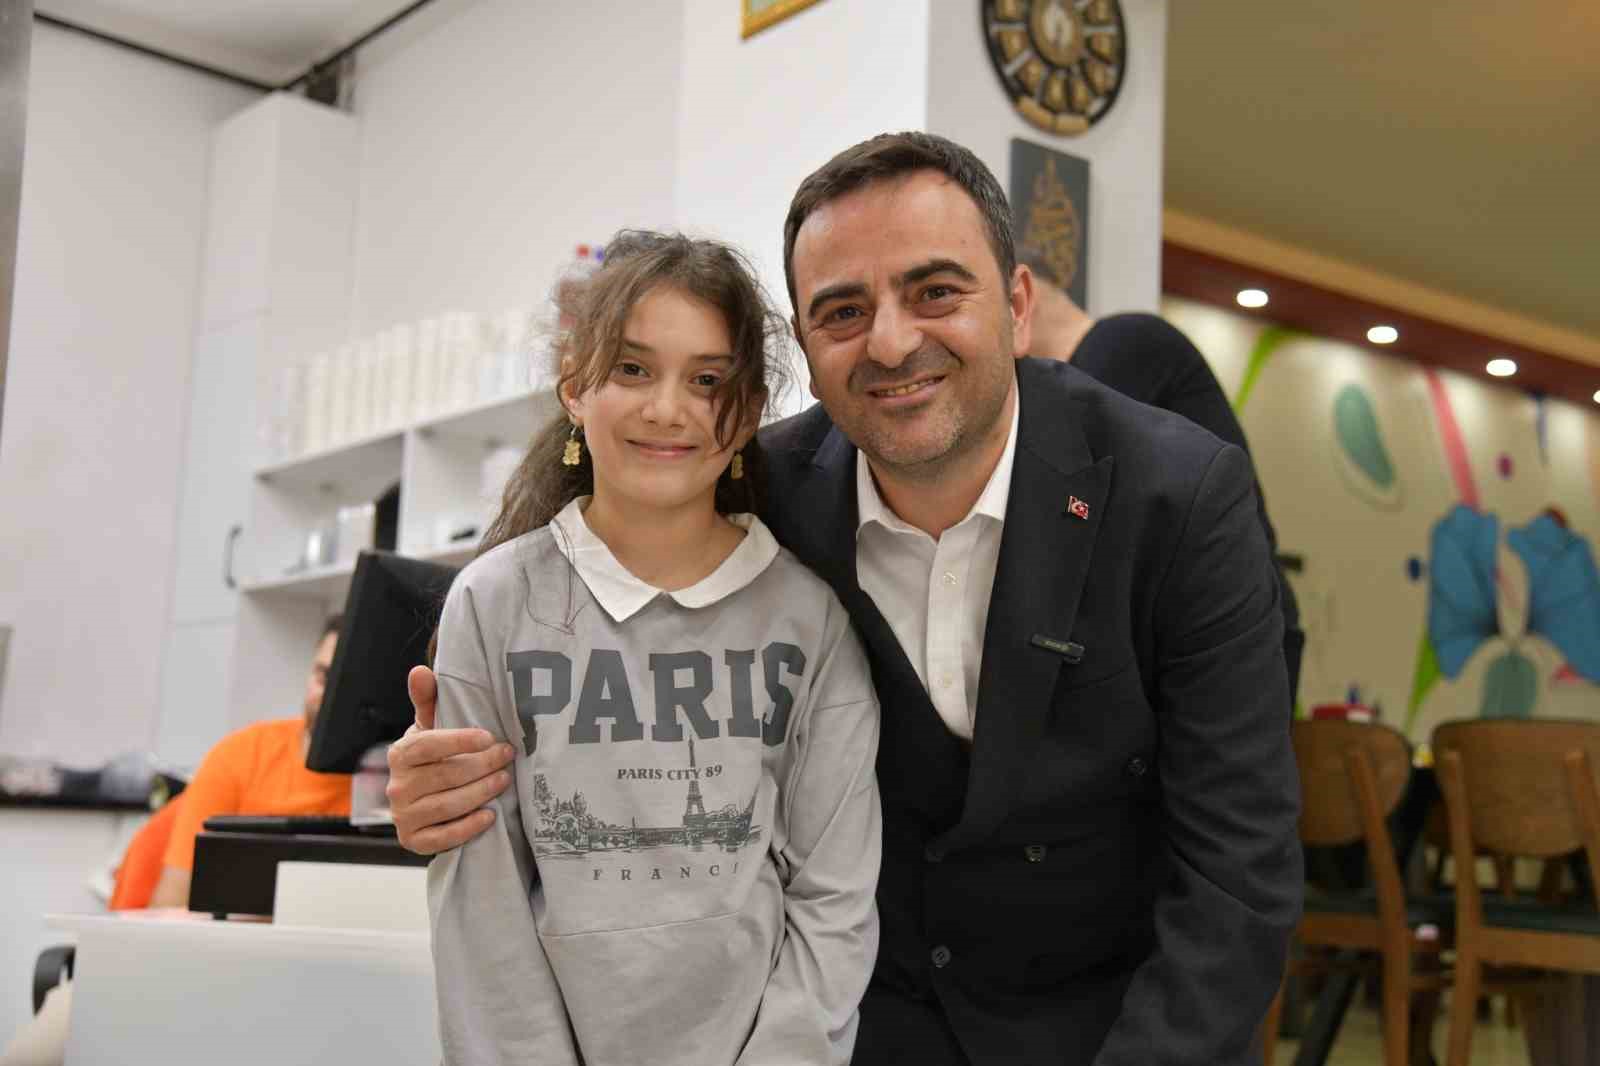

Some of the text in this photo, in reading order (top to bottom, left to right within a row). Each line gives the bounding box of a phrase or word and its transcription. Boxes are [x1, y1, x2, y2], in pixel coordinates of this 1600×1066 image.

[506, 641, 807, 756] PARIS
[617, 764, 723, 781] PARIS CITY 89
